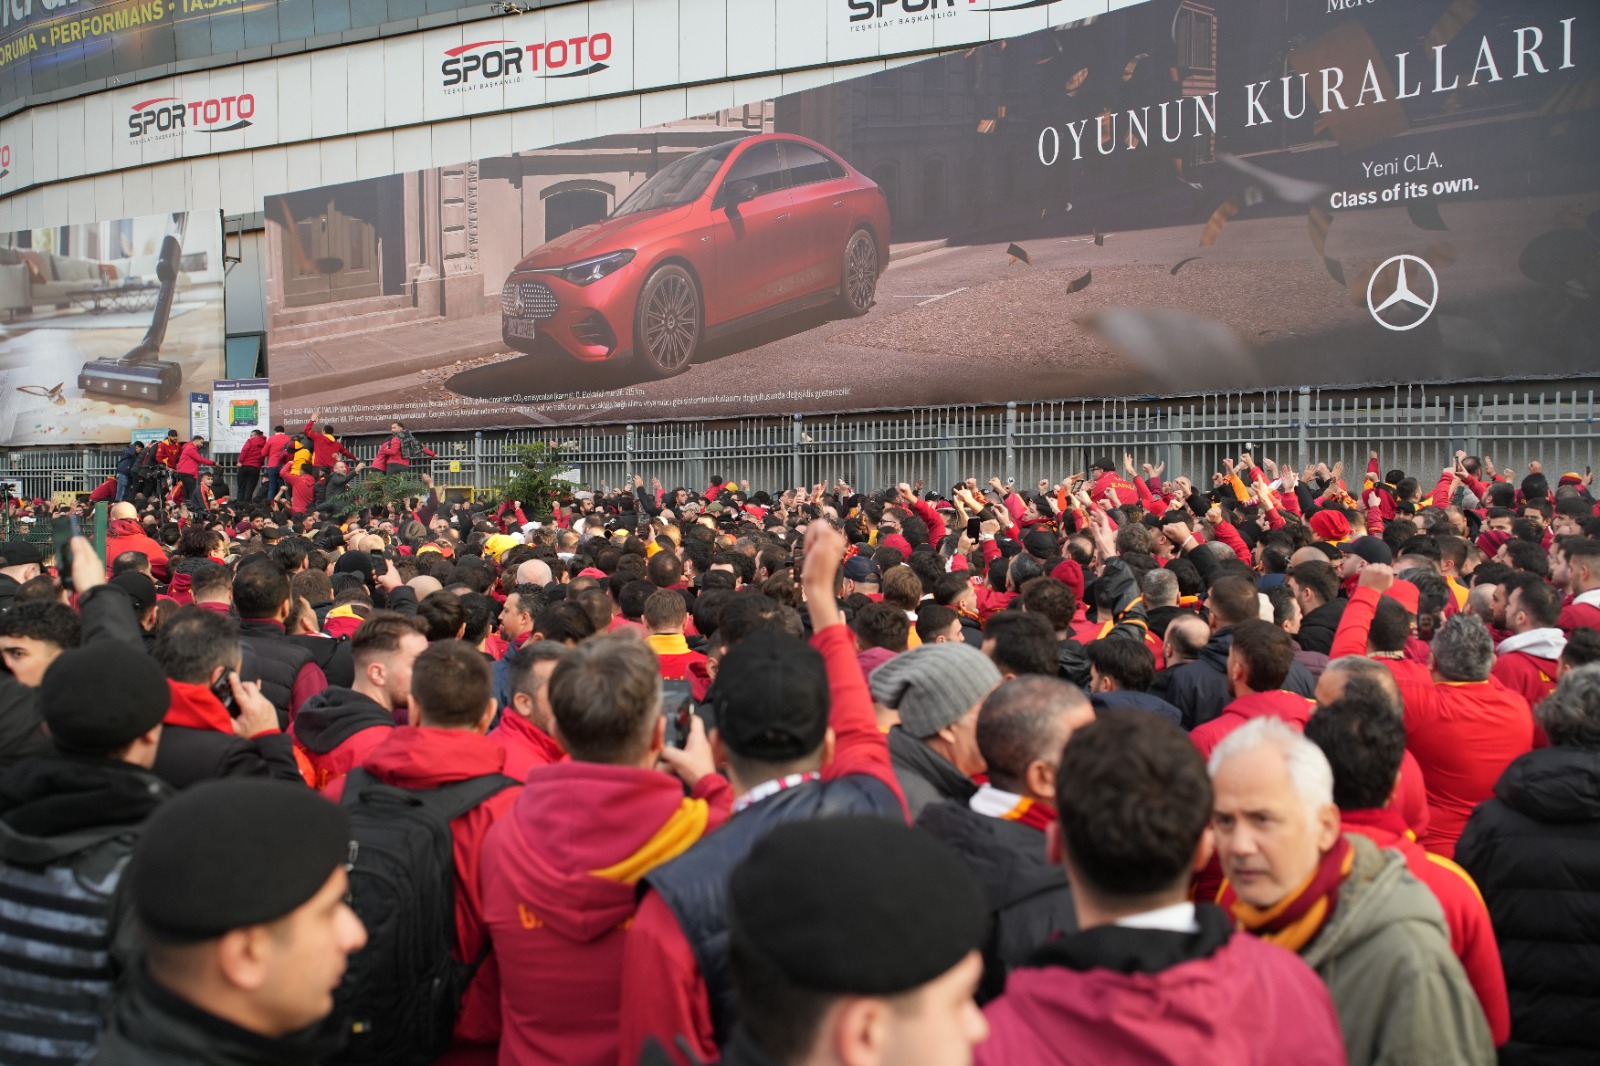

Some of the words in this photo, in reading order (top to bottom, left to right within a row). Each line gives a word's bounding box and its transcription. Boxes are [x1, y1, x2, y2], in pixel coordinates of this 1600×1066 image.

[50, 0, 164, 46] PERFORMANS
[1038, 91, 1219, 166] OYUNUN
[1245, 17, 1577, 128] KURALLARI
[1362, 158, 1399, 179] Yeni
[1404, 151, 1443, 173] CLA.
[1330, 191, 1377, 209] Class
[1381, 183, 1401, 202] of
[1404, 181, 1428, 199] its
[1432, 177, 1480, 196] own.
